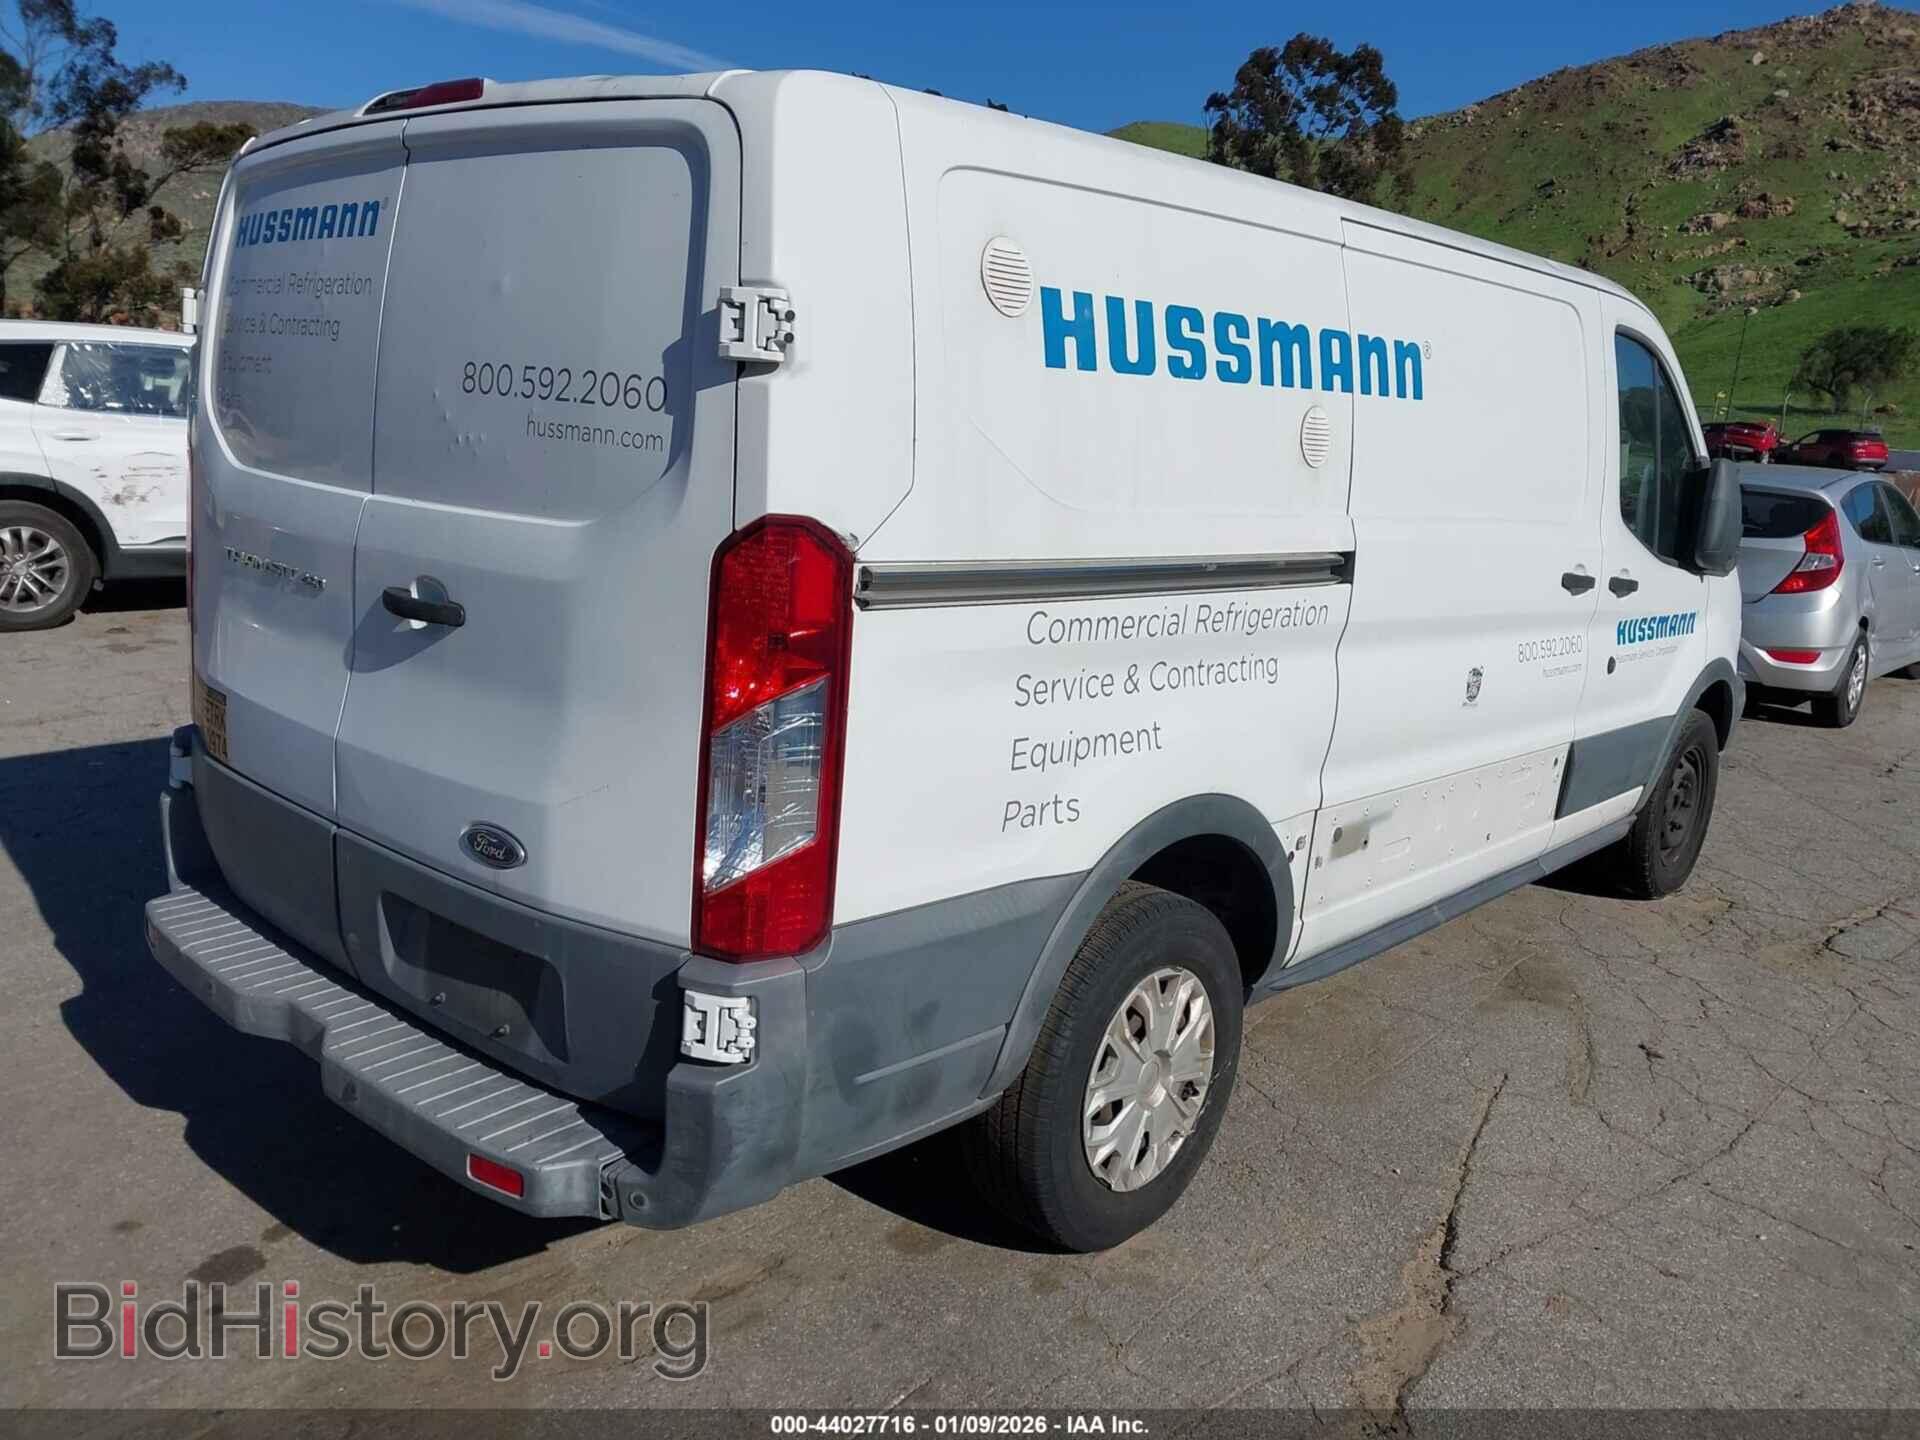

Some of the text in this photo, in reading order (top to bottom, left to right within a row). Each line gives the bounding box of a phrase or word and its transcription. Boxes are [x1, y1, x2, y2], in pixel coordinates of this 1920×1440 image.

[270, 312, 341, 342] Contracting
[462, 361, 668, 412] 800.592.2060
[526, 415, 664, 452] hussmann.com
[1027, 599, 1328, 645] Commercial Refrigeration
[1518, 635, 1583, 663] 800.592.2060
[1014, 653, 1279, 707] Service & Contracting
[1010, 721, 1162, 772] Equipment
[1001, 793, 1080, 832] Parts
[474, 832, 505, 860] Ford
